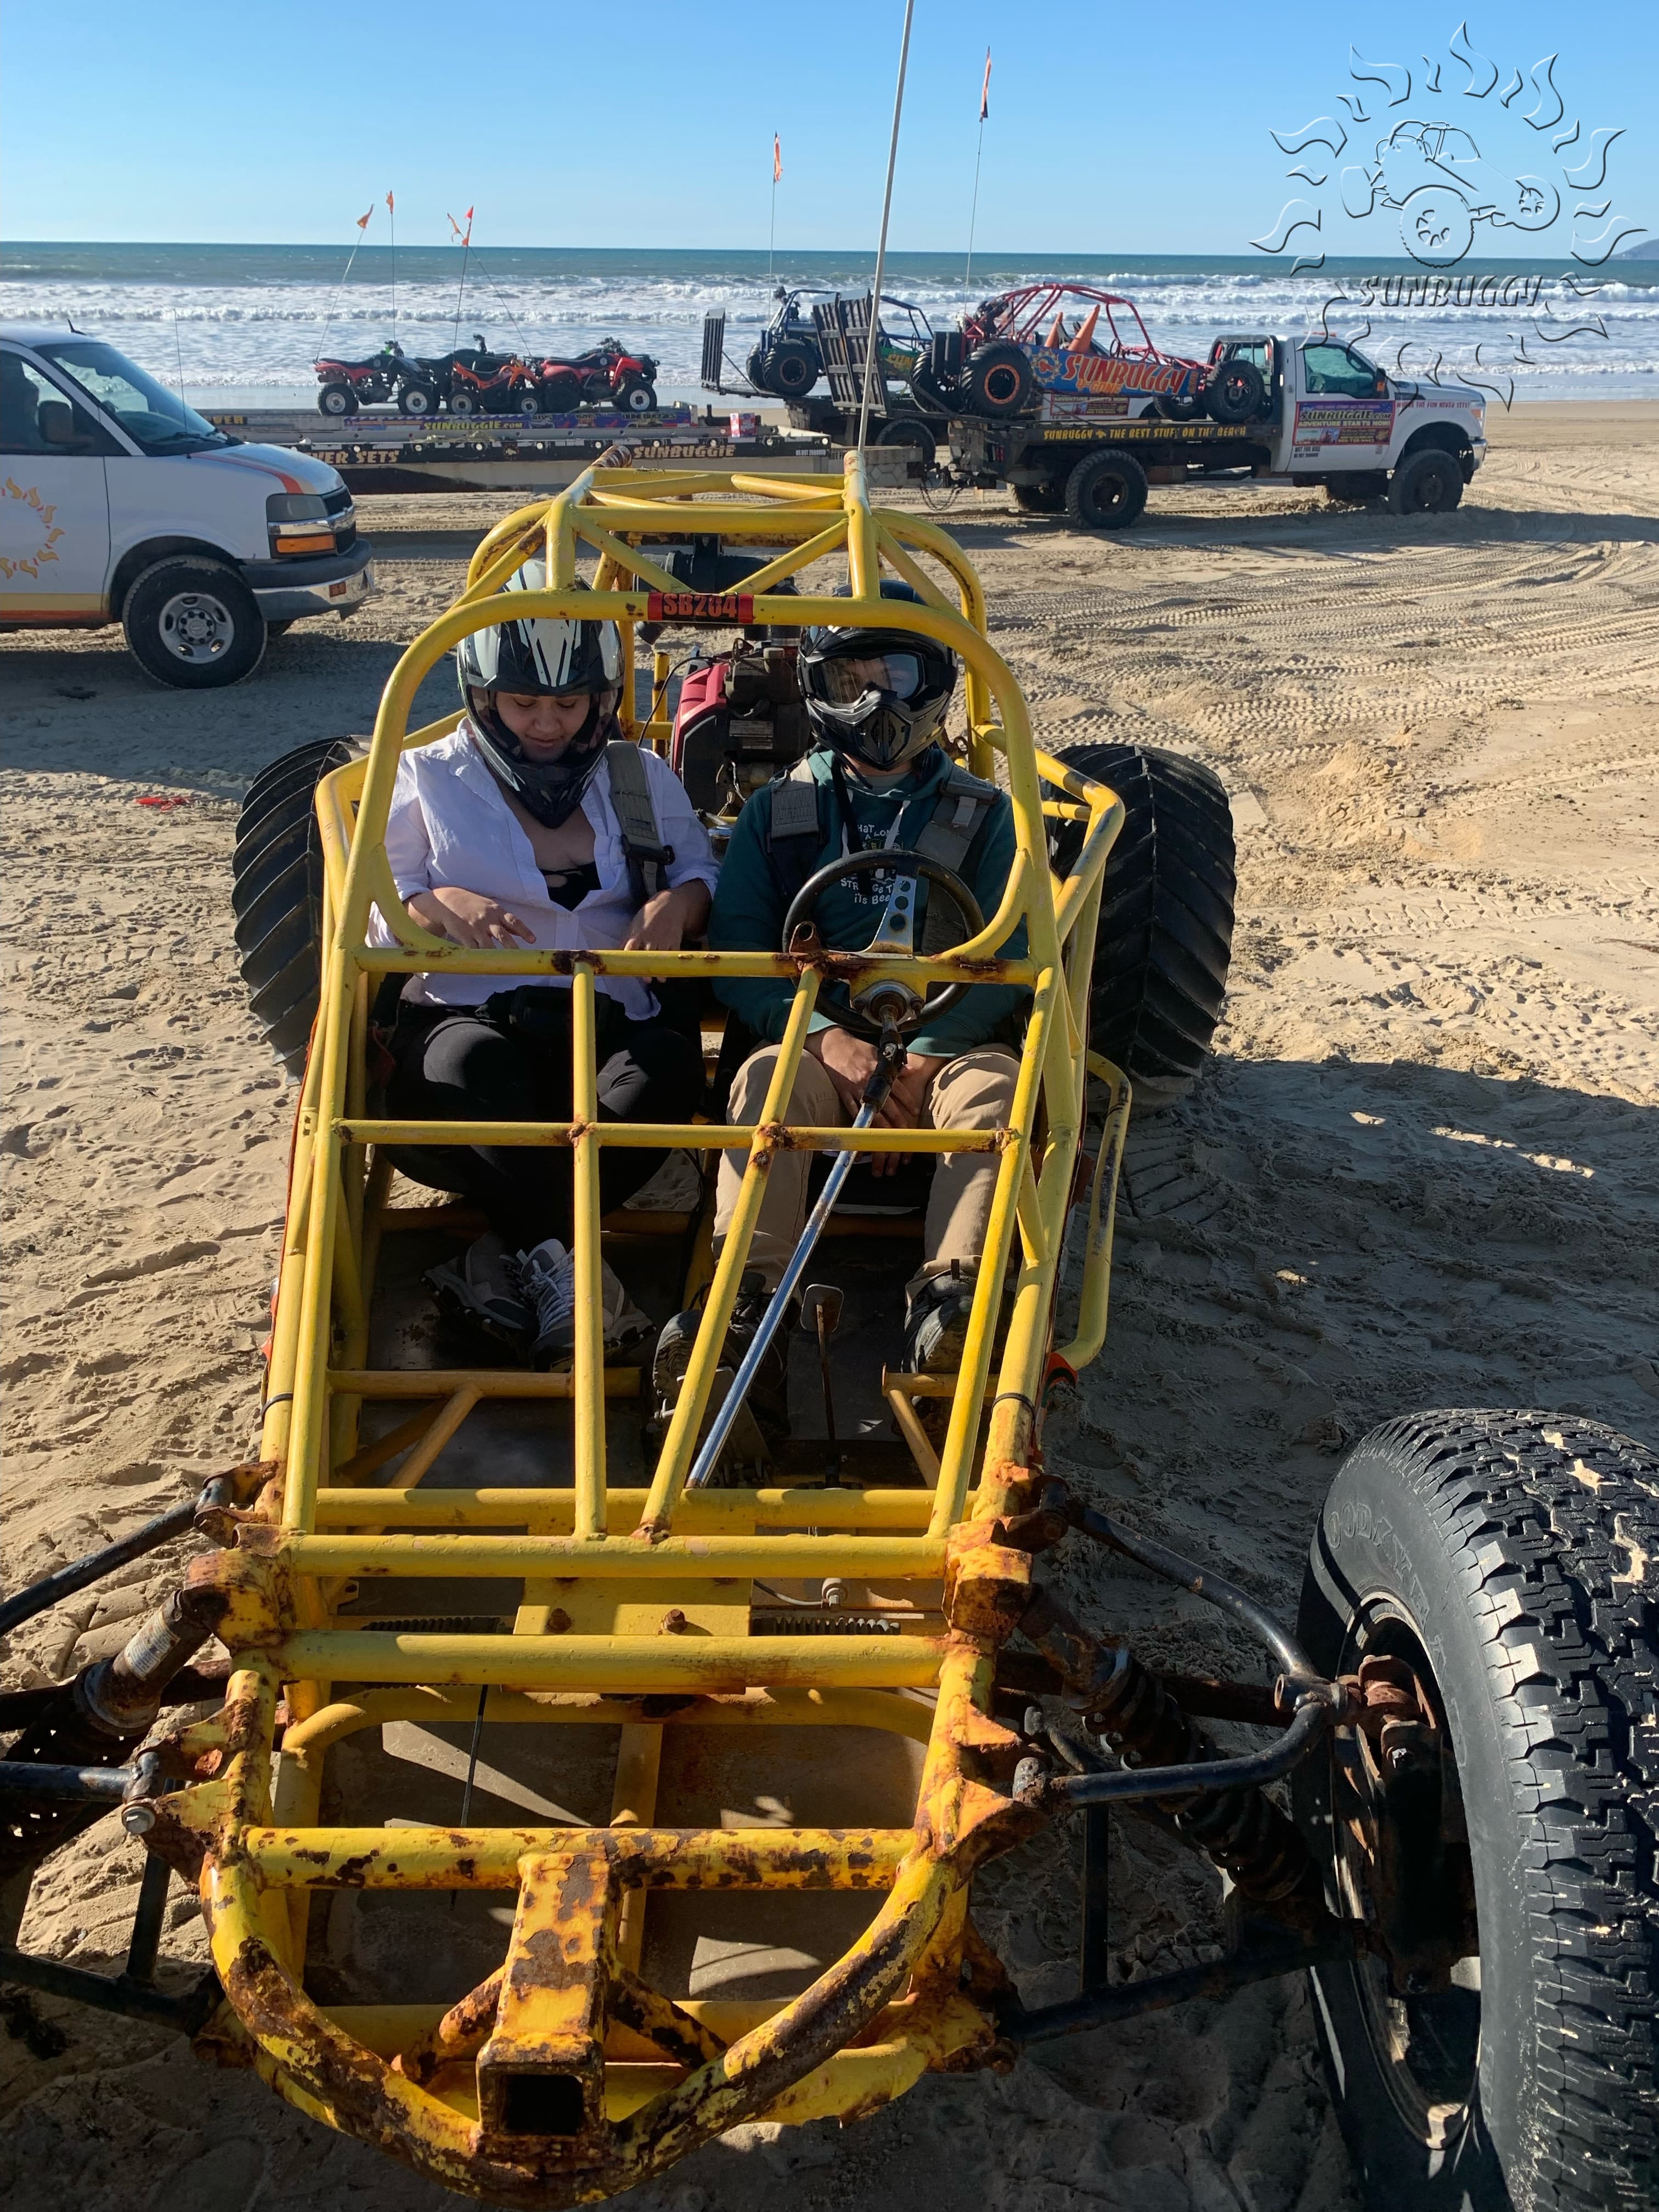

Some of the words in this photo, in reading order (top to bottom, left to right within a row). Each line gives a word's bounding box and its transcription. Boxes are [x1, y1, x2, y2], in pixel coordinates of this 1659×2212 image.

[1062, 354, 1188, 394] SUNBUGGY
[1044, 430, 1093, 439] SUNBUGGY
[1110, 429, 1126, 438] THE
[1129, 428, 1151, 438] BEST
[1182, 427, 1195, 437] ON
[356, 450, 399, 464] SETS
[633, 445, 736, 458] SUNBUGGIE
[664, 594, 737, 618] SB204
[872, 894, 891, 905] Bee
